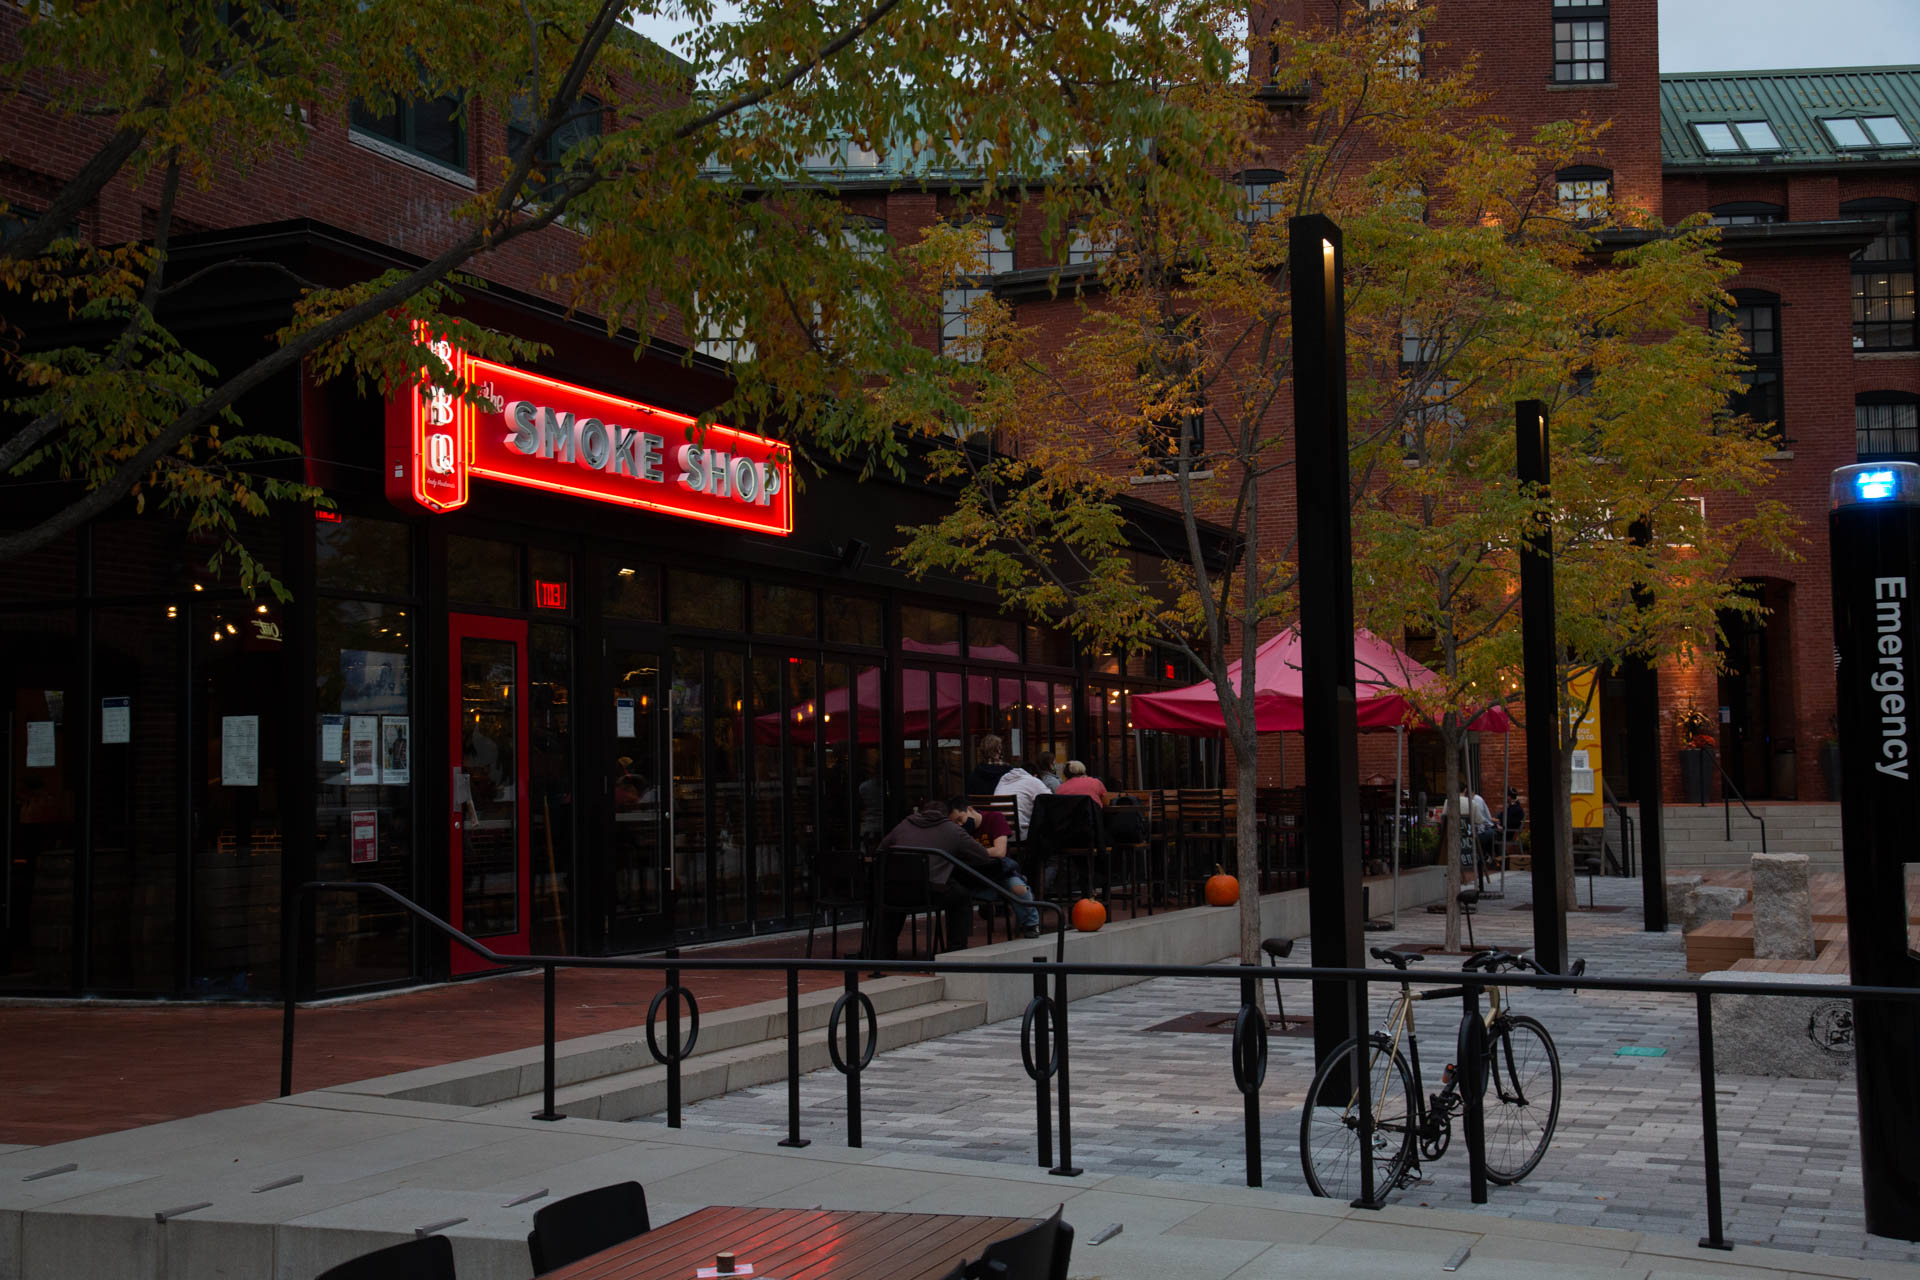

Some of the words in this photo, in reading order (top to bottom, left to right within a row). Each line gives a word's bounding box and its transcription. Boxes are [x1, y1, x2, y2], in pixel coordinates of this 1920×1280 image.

[504, 401, 664, 483] SMOKE
[677, 444, 781, 506] SHOP
[1870, 577, 1909, 780] Emergency
